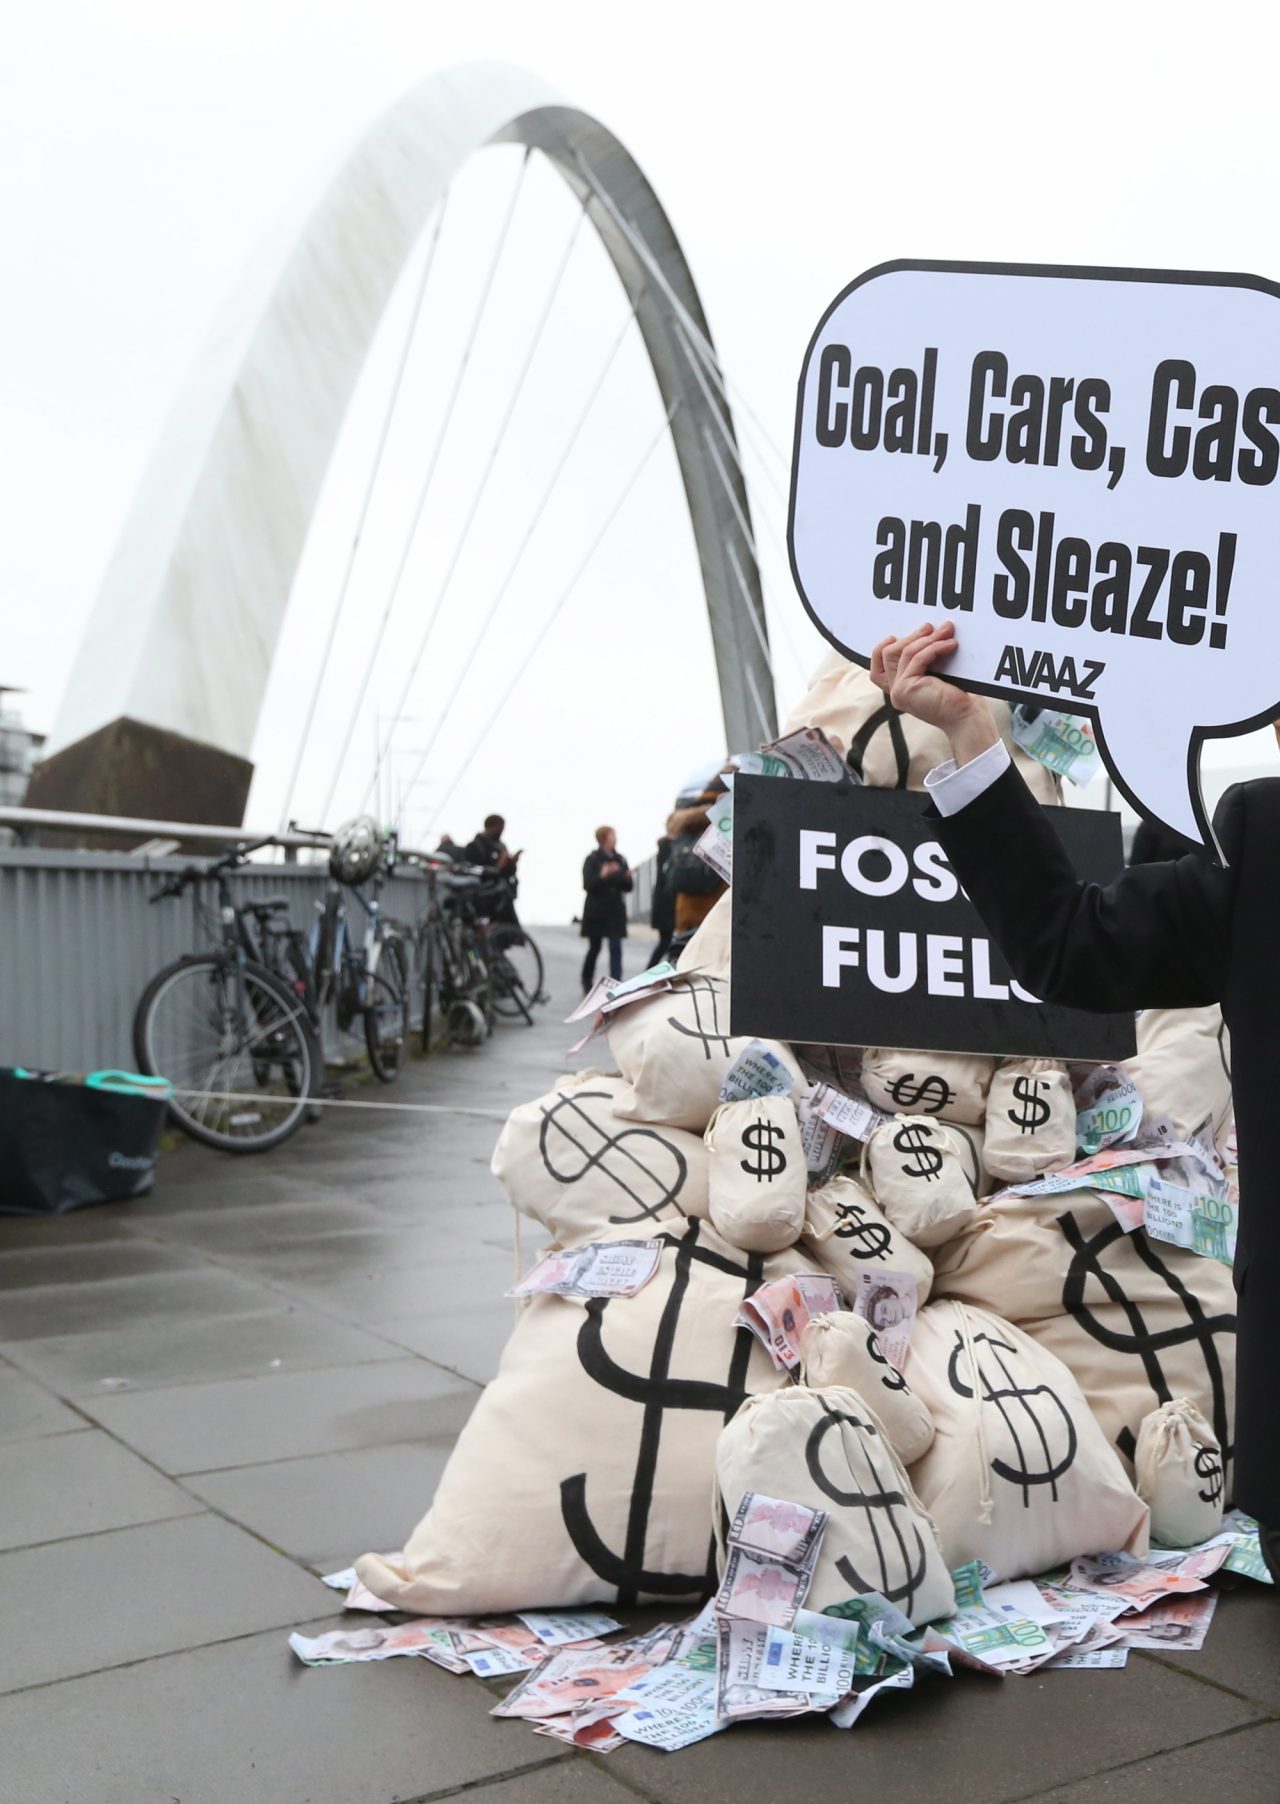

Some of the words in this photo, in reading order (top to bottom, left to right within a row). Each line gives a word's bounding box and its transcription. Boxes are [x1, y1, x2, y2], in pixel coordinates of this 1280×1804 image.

[814, 343, 949, 474] Coal,
[965, 350, 1126, 491] Cars,
[872, 503, 982, 612] and
[992, 508, 1238, 649] Sleaze!
[994, 645, 1106, 700] AVAAZ
[799, 828, 971, 903] FOS
[822, 924, 1045, 1004] FUEL
[736, 1066, 756, 1082] THE
[745, 1057, 776, 1083] WHERE
[1100, 1107, 1132, 1131] 100
[801, 1654, 816, 1682] THE
